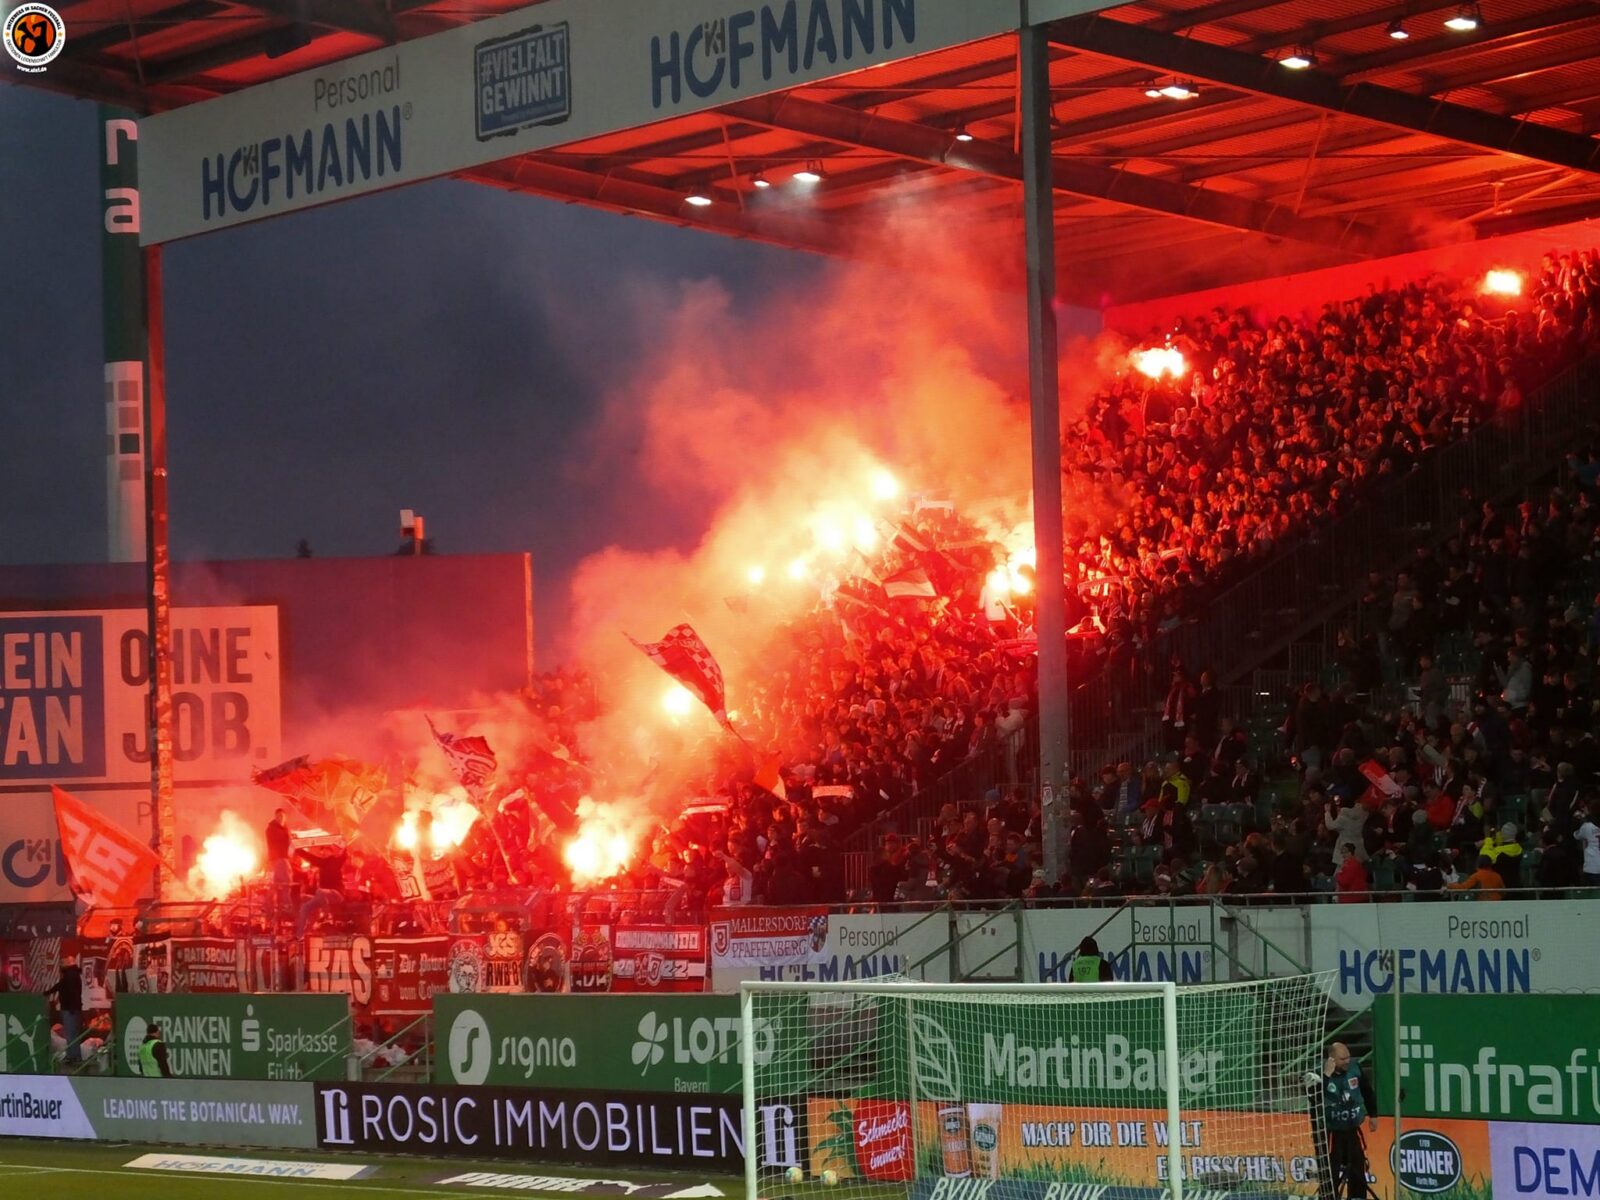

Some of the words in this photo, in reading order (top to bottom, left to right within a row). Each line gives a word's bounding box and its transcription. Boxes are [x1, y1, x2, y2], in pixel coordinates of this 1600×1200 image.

[481, 33, 563, 83] #VIELFALT
[651, 0, 916, 108] HOFMANN
[314, 55, 400, 112] Personal
[482, 66, 564, 115] GEWINNT
[202, 104, 402, 221] HOFMANN
[0, 631, 83, 690] EIN
[0, 694, 84, 766] AN
[122, 691, 268, 764] JOB.
[730, 915, 809, 933] MALLERSDORF
[839, 926, 899, 946] Personal
[1133, 920, 1201, 943] Personal
[1448, 914, 1529, 939] Personal
[731, 939, 808, 959] PFAFFENBERG
[1039, 951, 1202, 983] HMANN
[1339, 949, 1531, 995] HOFMANN
[152, 1016, 231, 1044] FRANKEN
[267, 1027, 338, 1058] Sparkasse
[673, 1017, 776, 1065] LOTTO
[166, 1049, 232, 1076] RUNNEN
[267, 1061, 304, 1080] Füth
[498, 1036, 577, 1079] signia
[674, 1077, 708, 1093] Bayern
[0, 1092, 62, 1120] rtinBauer
[103, 1098, 158, 1120] LEADING
[161, 1099, 187, 1121] THE
[190, 1102, 265, 1125] BOTANICAL
[267, 1103, 303, 1126] WAY.
[1330, 1105, 1361, 1121] HOST
[361, 1094, 479, 1145] ROSIC
[493, 1099, 746, 1159] IMMOBILIEN
[858, 1106, 907, 1147] Schmeckt
[1021, 1121, 1075, 1147] MACH'
[1080, 1121, 1112, 1147] DIR
[1116, 1121, 1147, 1147] DIE
[1152, 1120, 1203, 1148] WLT
[152, 1159, 317, 1176] HOFMANN
[1156, 1154, 1187, 1181] EN
[1191, 1155, 1287, 1183] BISSCHEN
